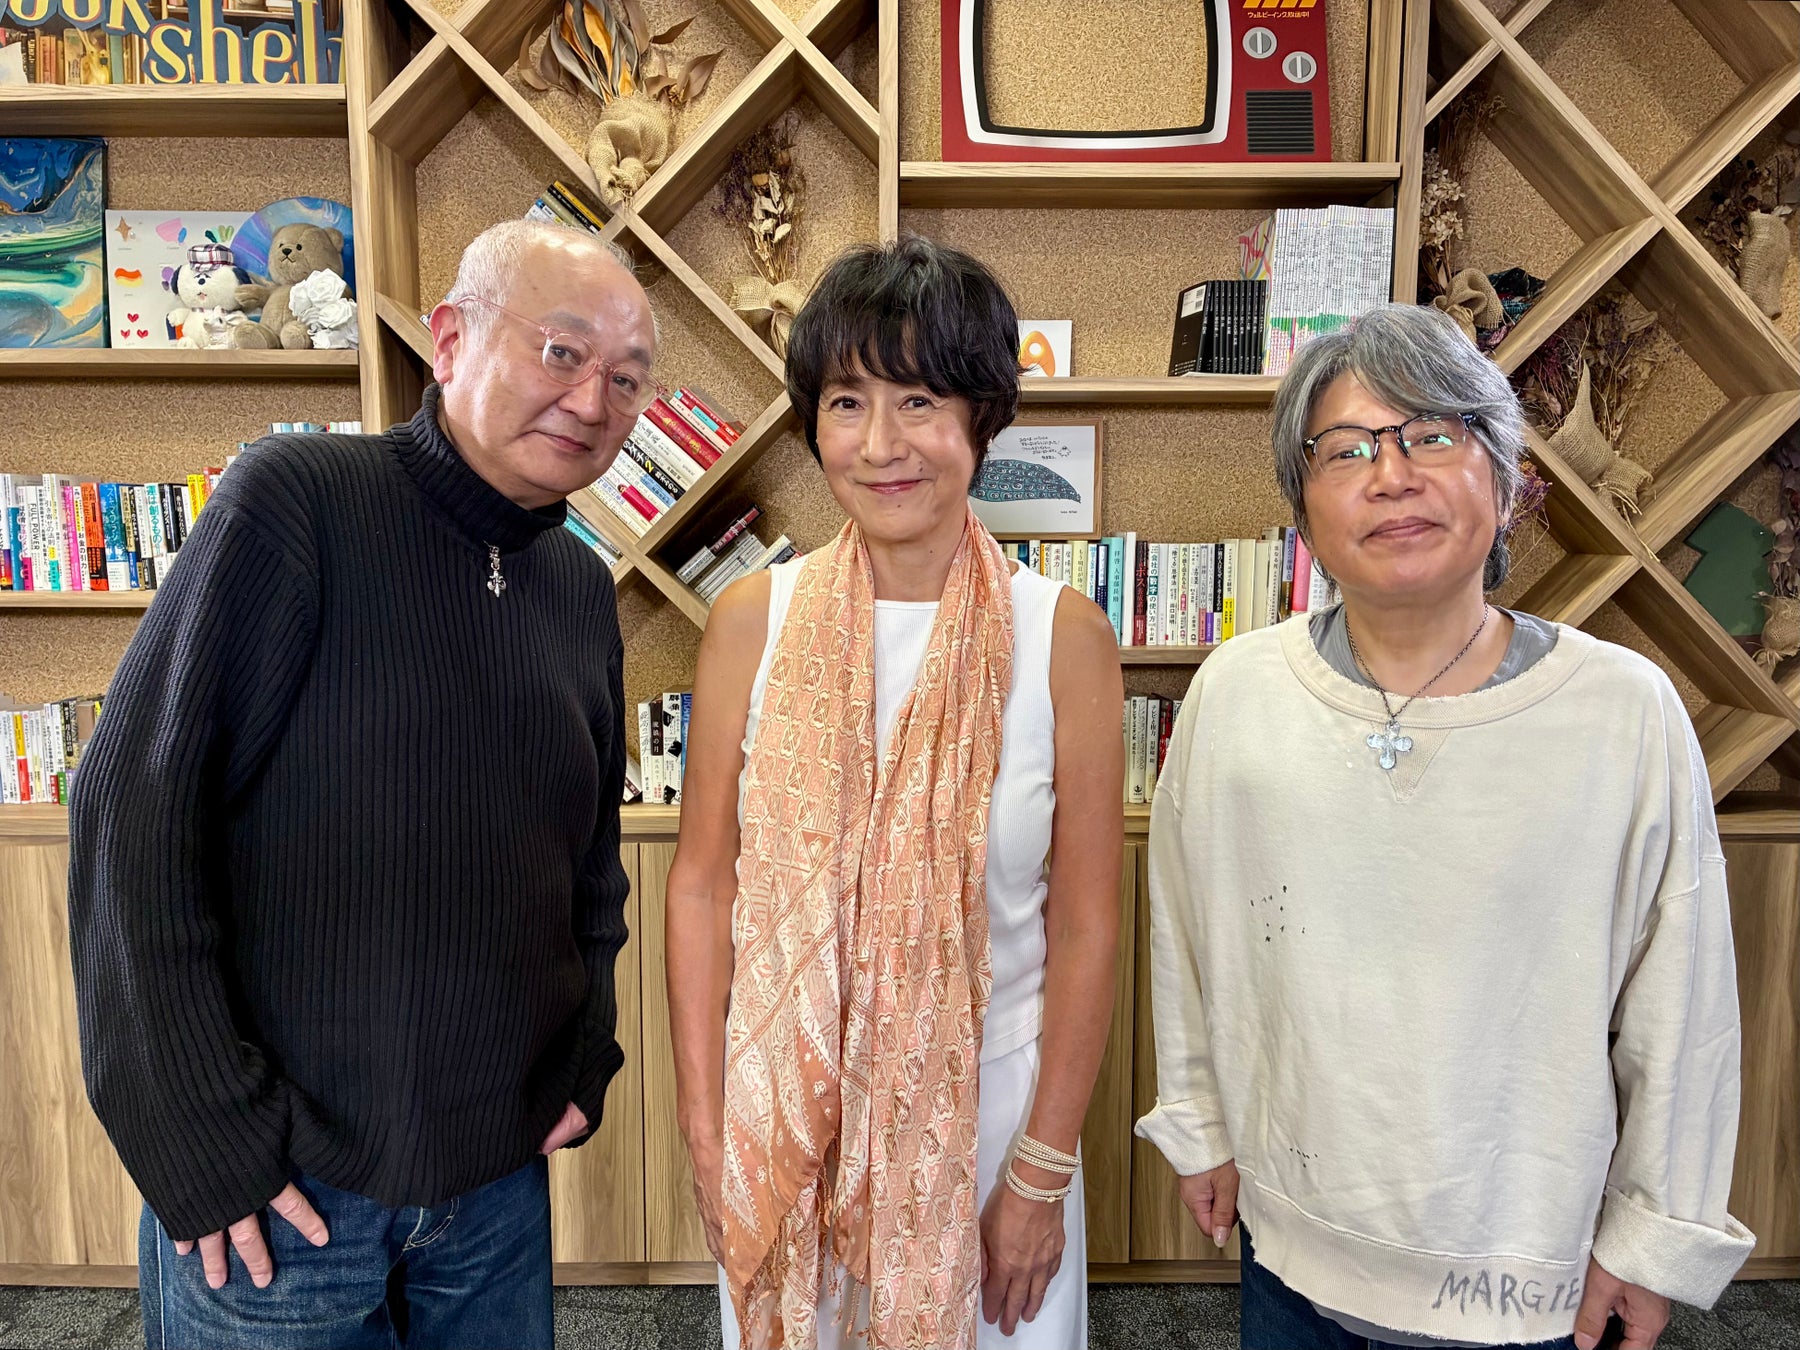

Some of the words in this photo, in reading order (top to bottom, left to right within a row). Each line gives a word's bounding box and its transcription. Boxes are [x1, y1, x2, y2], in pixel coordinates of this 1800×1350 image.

[150, 0, 344, 84] shel
[32, 524, 40, 550] POWER
[78, 533, 87, 568] お金の引力
[1031, 546, 1040, 568] 天才
[1148, 554, 1159, 622] 会社の数字の使い方
[1431, 1269, 1580, 1319] MARGIE
